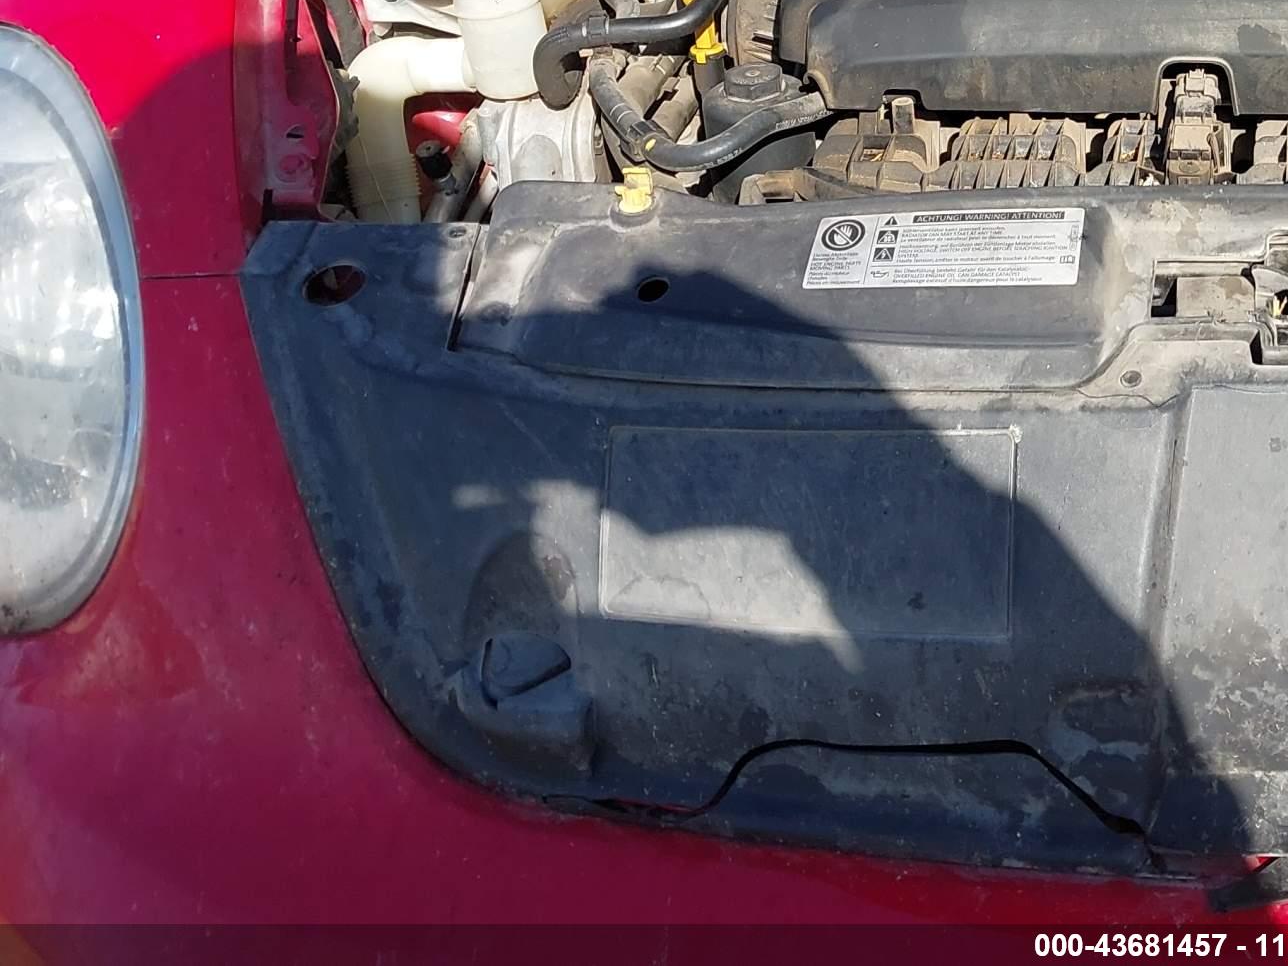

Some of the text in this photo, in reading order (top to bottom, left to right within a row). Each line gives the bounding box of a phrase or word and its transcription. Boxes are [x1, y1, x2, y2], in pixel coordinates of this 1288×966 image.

[916, 212, 1064, 223] ACHTUNG! WARNING! ATTENTION!
